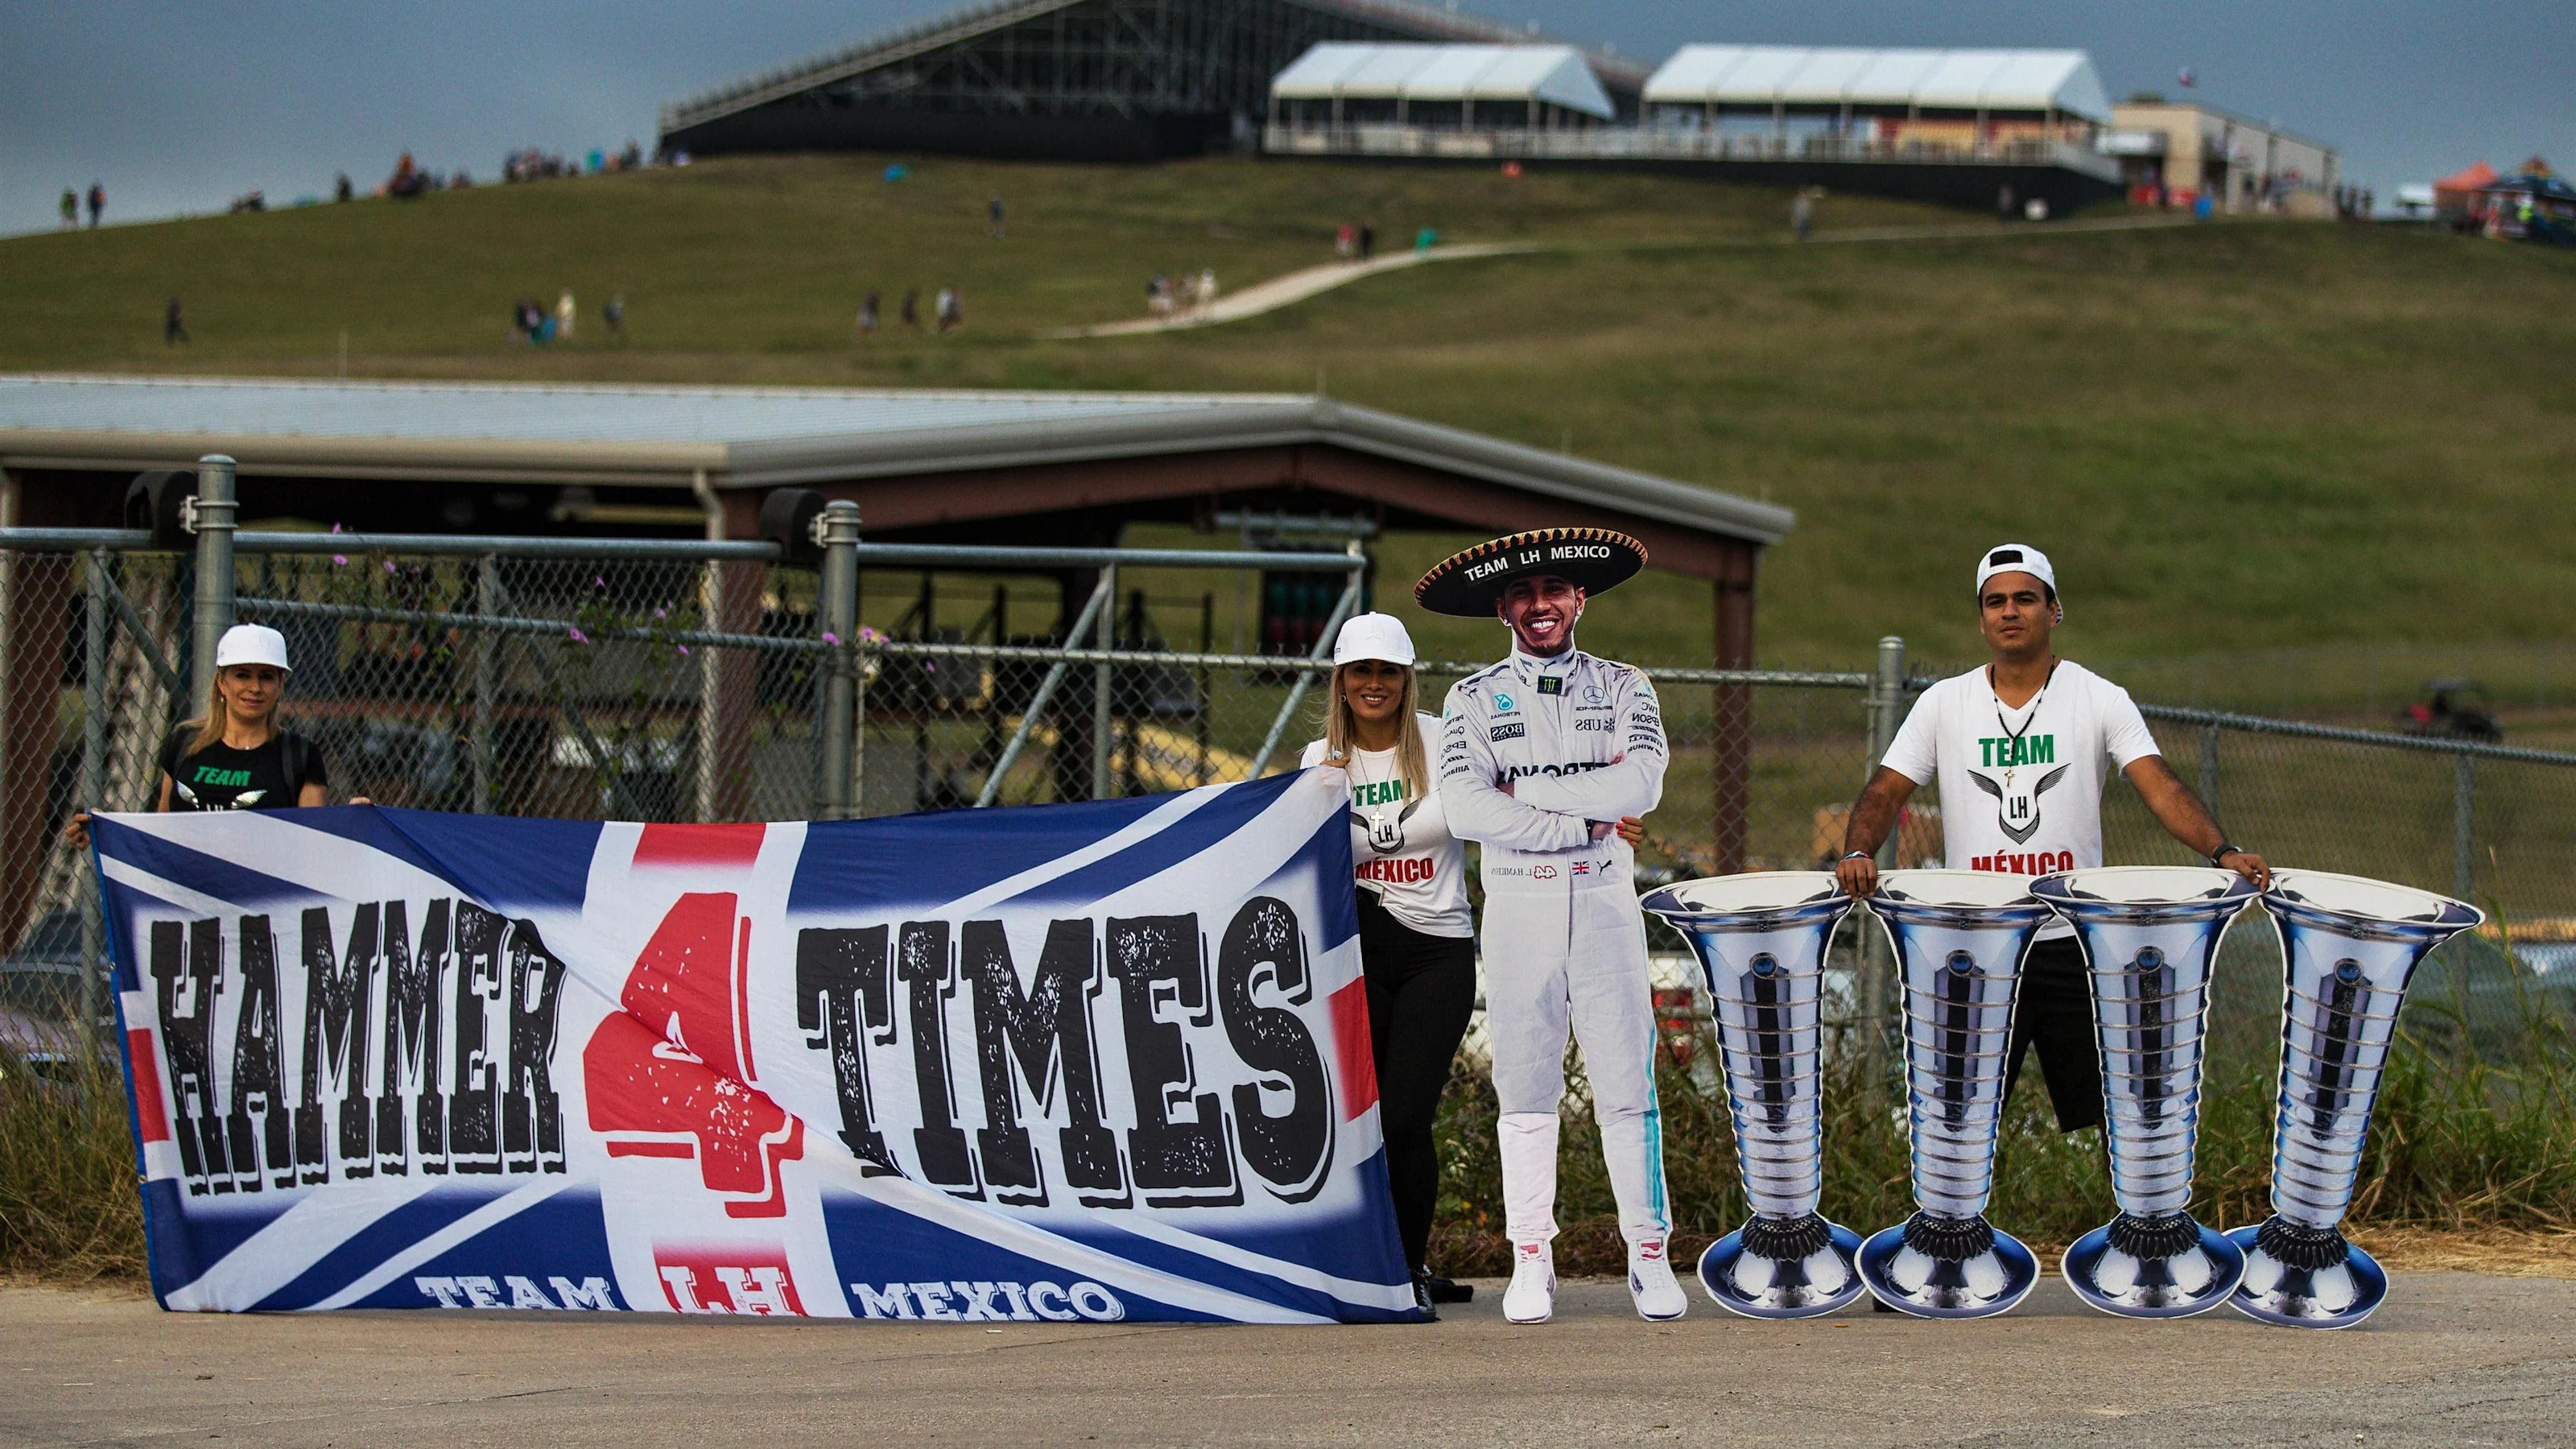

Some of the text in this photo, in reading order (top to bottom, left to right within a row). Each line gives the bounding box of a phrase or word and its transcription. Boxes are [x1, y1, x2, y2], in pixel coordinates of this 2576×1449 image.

[1464, 545, 1611, 582] TEAM LH MEXICO
[1978, 734, 2054, 767] TEAM
[193, 766, 251, 786] TEAM
[1353, 778, 1412, 807] TEAM
[2009, 796, 2028, 819] LH
[1377, 824, 1394, 843] LH
[1355, 856, 1434, 883] MÉXICO
[150, 891, 1335, 1218] HAMMER 4 TIMES
[414, 1265, 1126, 1323] TEAM LH MEXICO
